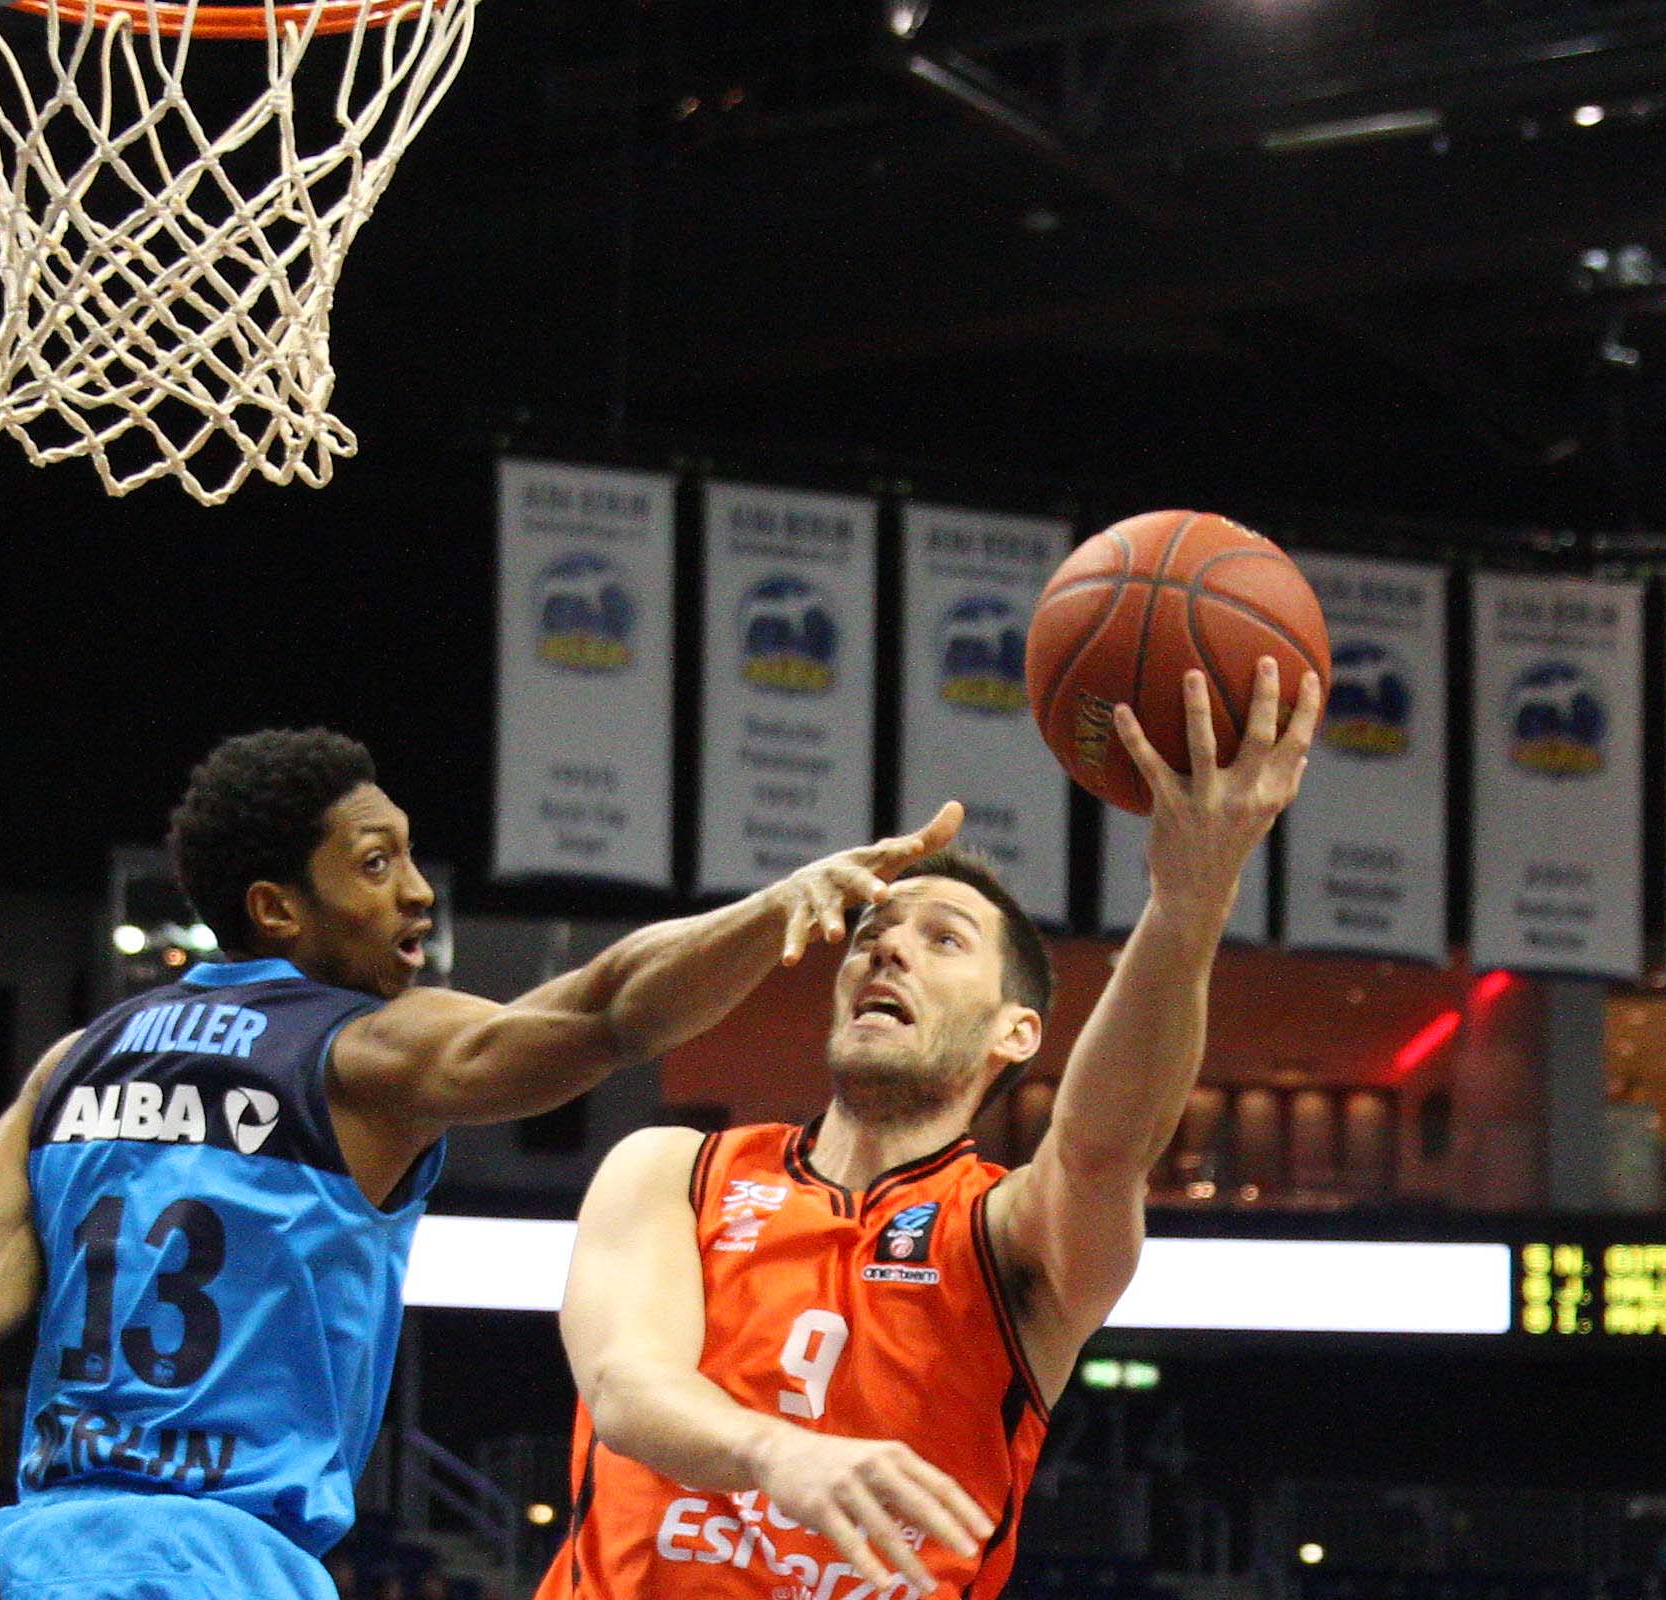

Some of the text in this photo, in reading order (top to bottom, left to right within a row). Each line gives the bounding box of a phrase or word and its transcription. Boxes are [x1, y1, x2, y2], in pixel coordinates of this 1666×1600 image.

[113, 1003, 268, 1059] MILLER
[52, 1080, 207, 1145] ALBA
[60, 1196, 226, 1389] 13
[778, 1308, 849, 1420] 9
